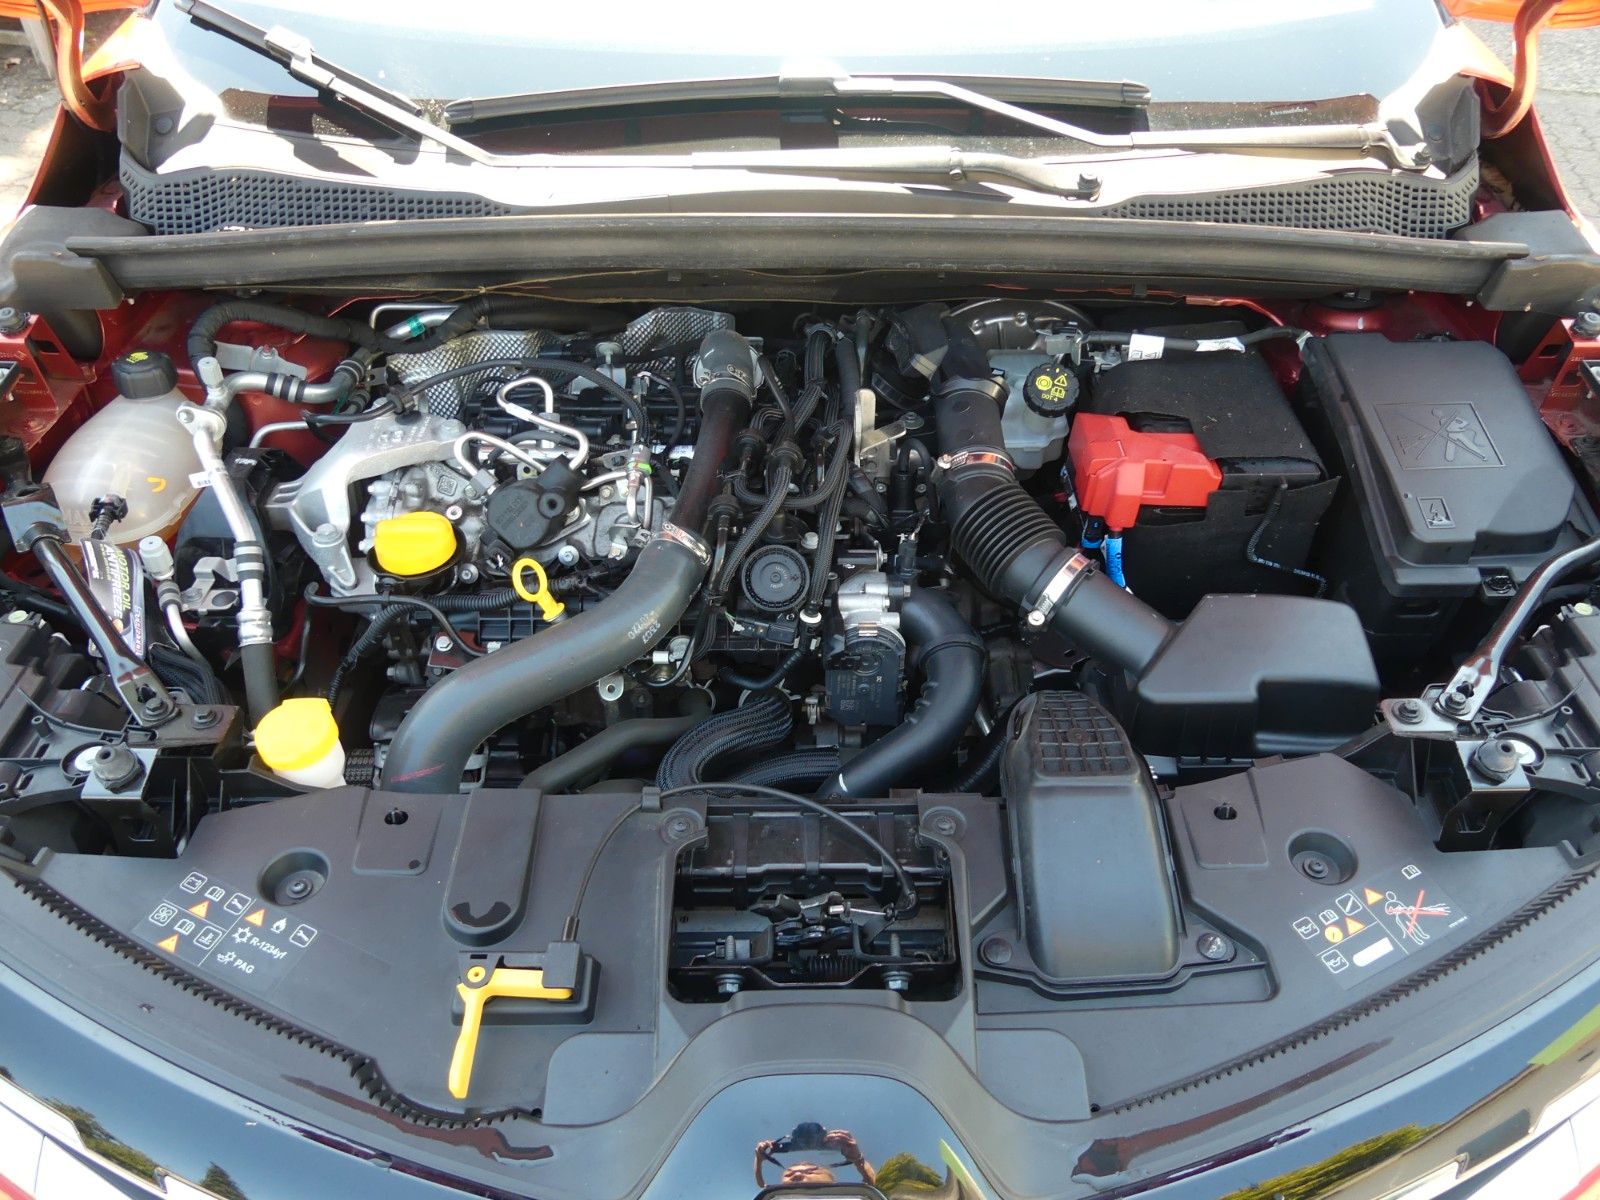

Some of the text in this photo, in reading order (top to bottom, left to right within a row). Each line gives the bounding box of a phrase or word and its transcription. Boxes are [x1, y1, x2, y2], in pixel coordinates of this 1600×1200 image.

[1041, 393, 1054, 401] DOT
[103, 543, 123, 619] ANTIFREEZE
[116, 549, 131, 611] MOTOR OIL
[249, 936, 288, 959] R-1234yf
[233, 959, 255, 974] PAG
